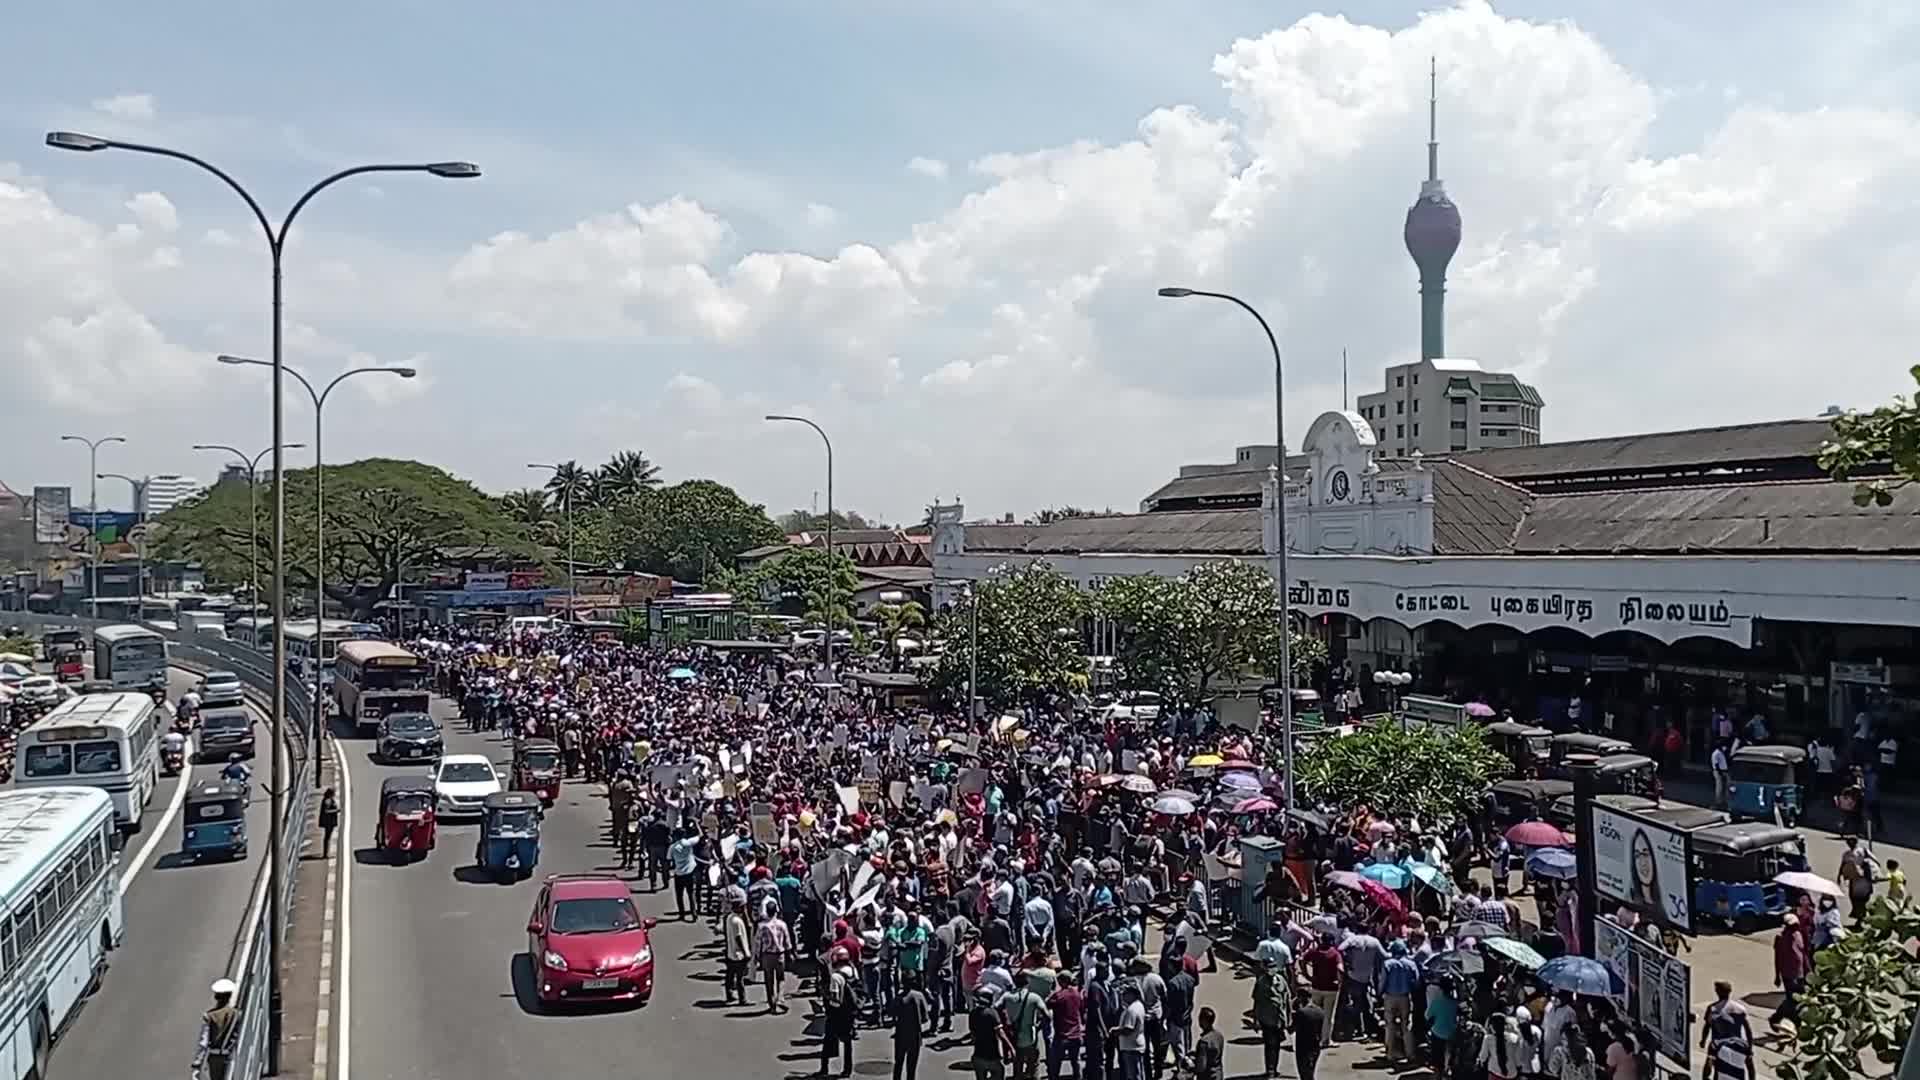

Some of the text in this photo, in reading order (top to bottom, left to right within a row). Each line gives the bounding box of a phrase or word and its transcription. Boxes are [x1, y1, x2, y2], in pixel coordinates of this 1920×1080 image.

[1395, 592, 1729, 626] கோட்டை புகையிரத நிலையம்
